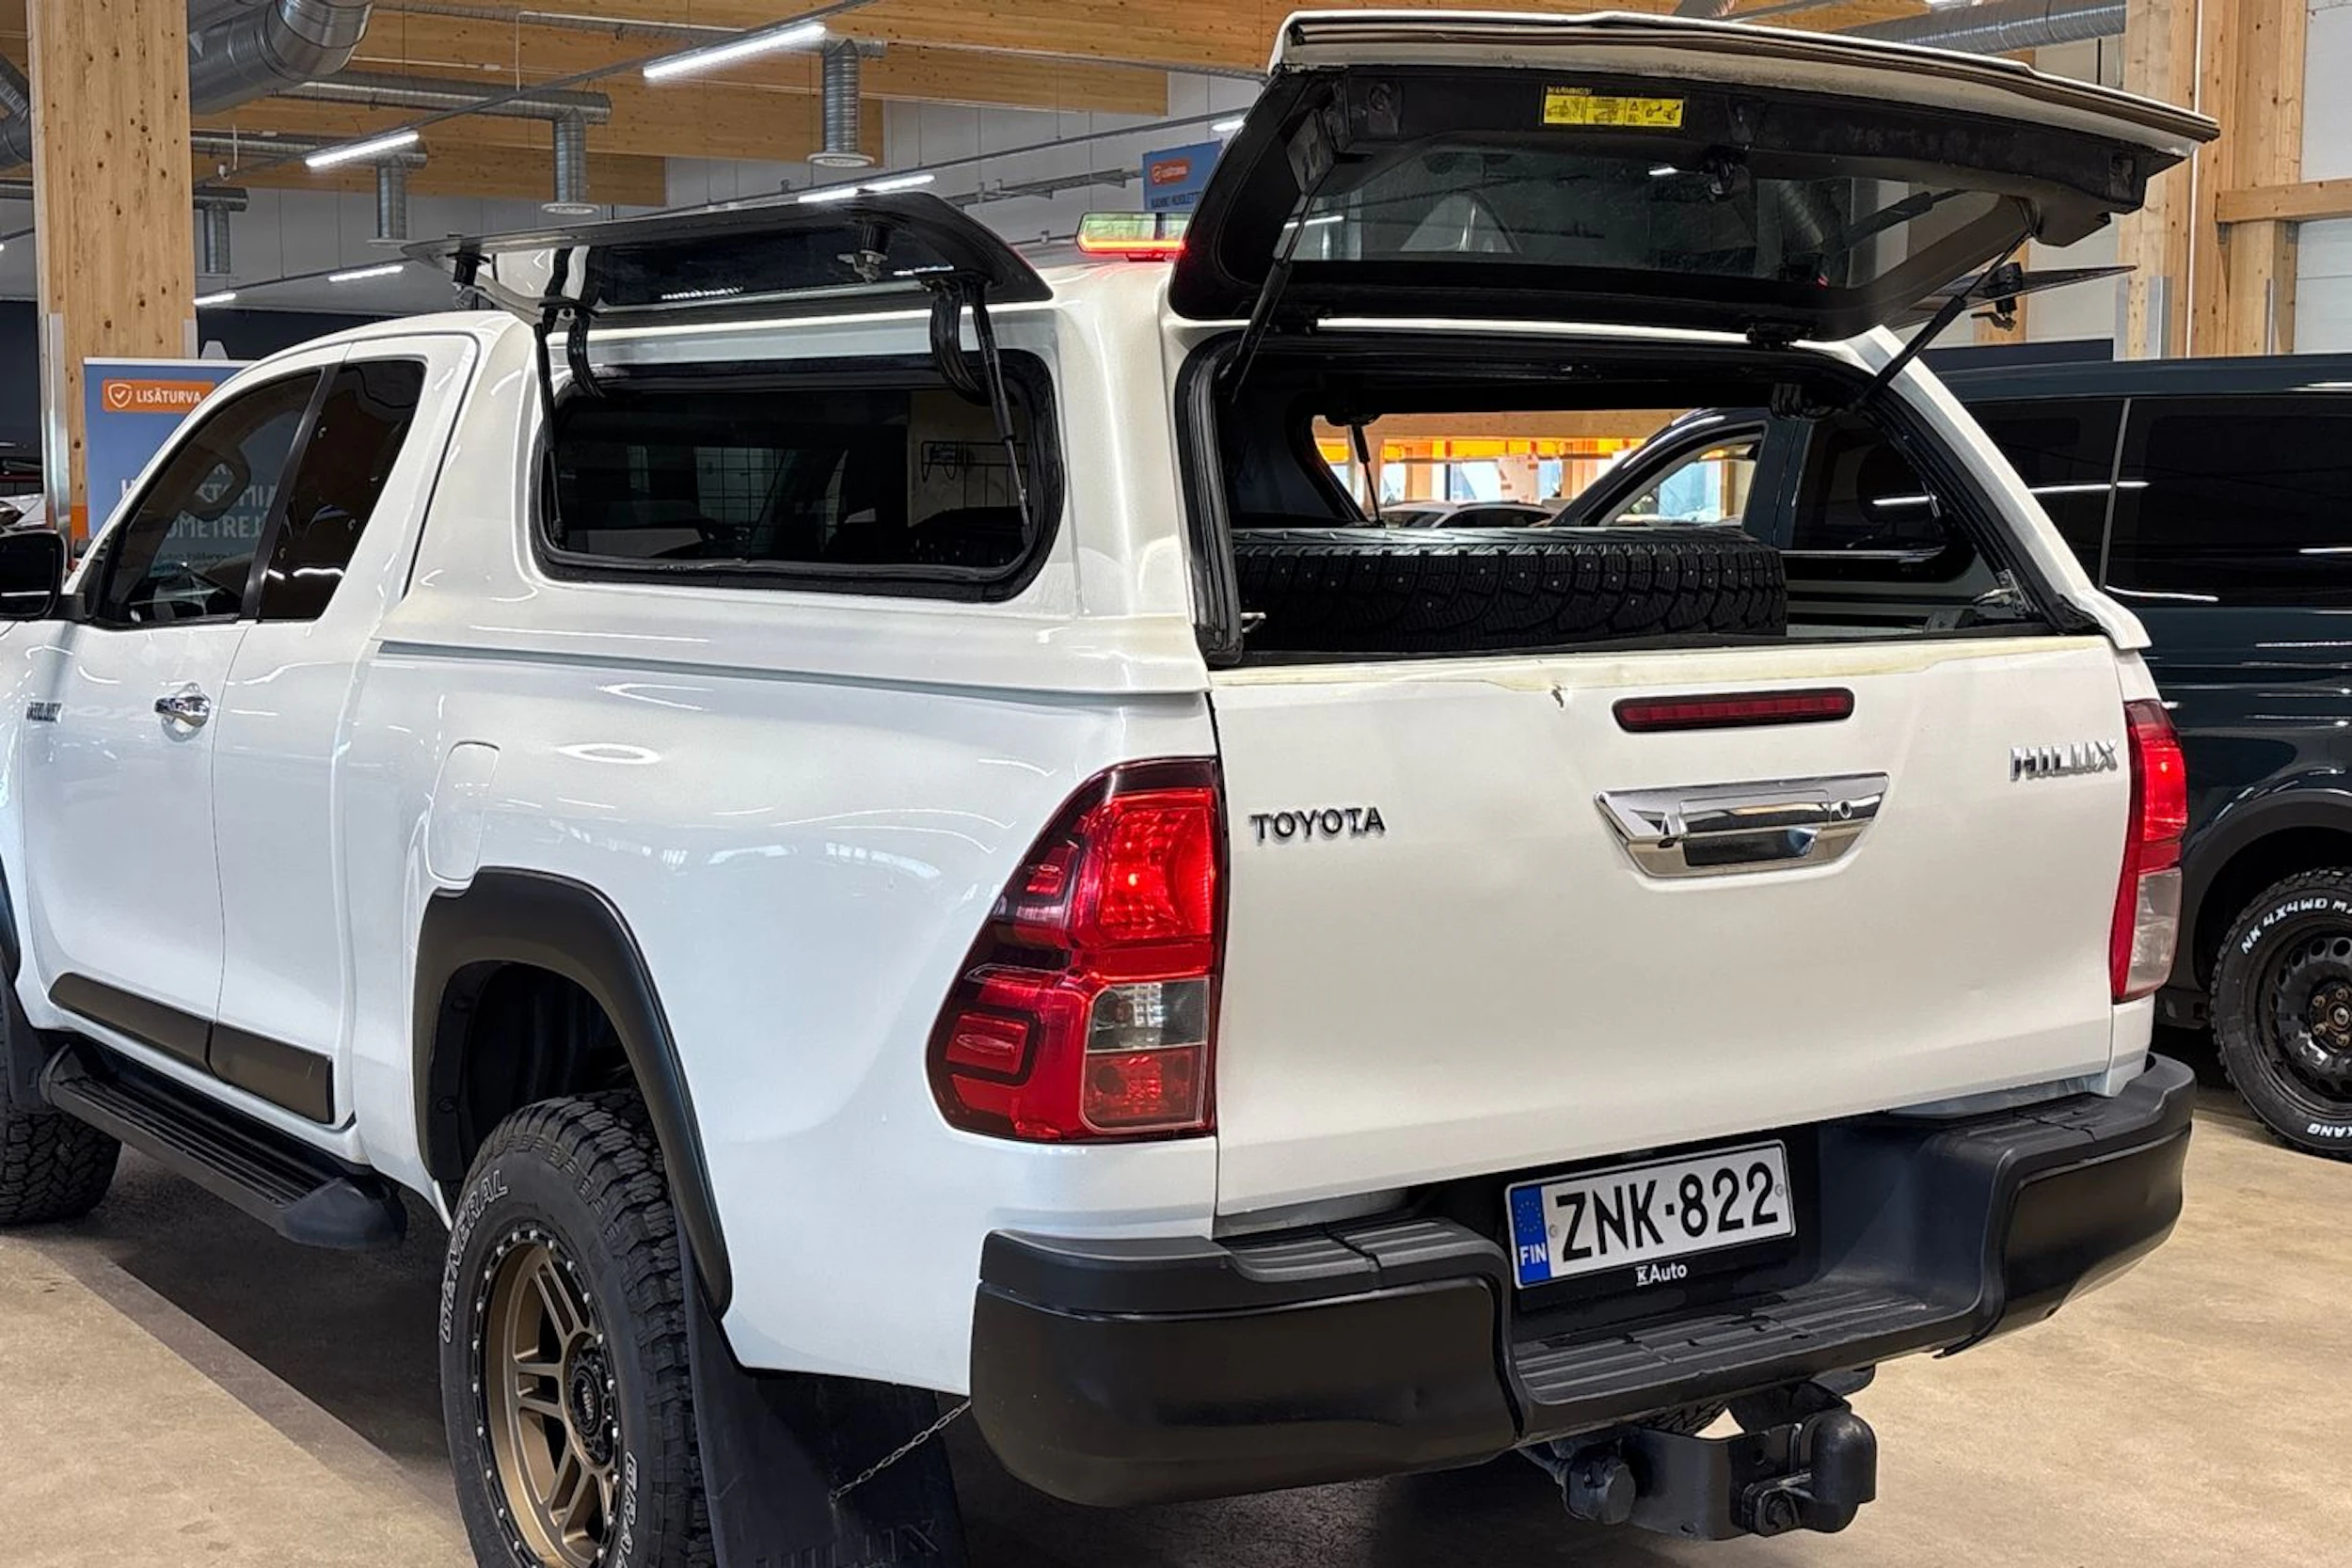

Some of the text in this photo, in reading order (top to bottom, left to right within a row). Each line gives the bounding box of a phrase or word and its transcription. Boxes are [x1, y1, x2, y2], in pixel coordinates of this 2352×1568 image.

[135, 387, 203, 404] LISÄTURVA
[2010, 738, 2118, 782] HILUX
[1249, 806, 1386, 845] TOYOTA
[2241, 924, 2263, 955] NK
[1555, 1162, 1779, 1262] ZNK-822
[438, 1168, 510, 1344] GENERAL
[1519, 1243, 1548, 1267] FIN
[614, 1450, 638, 1568] GRA
